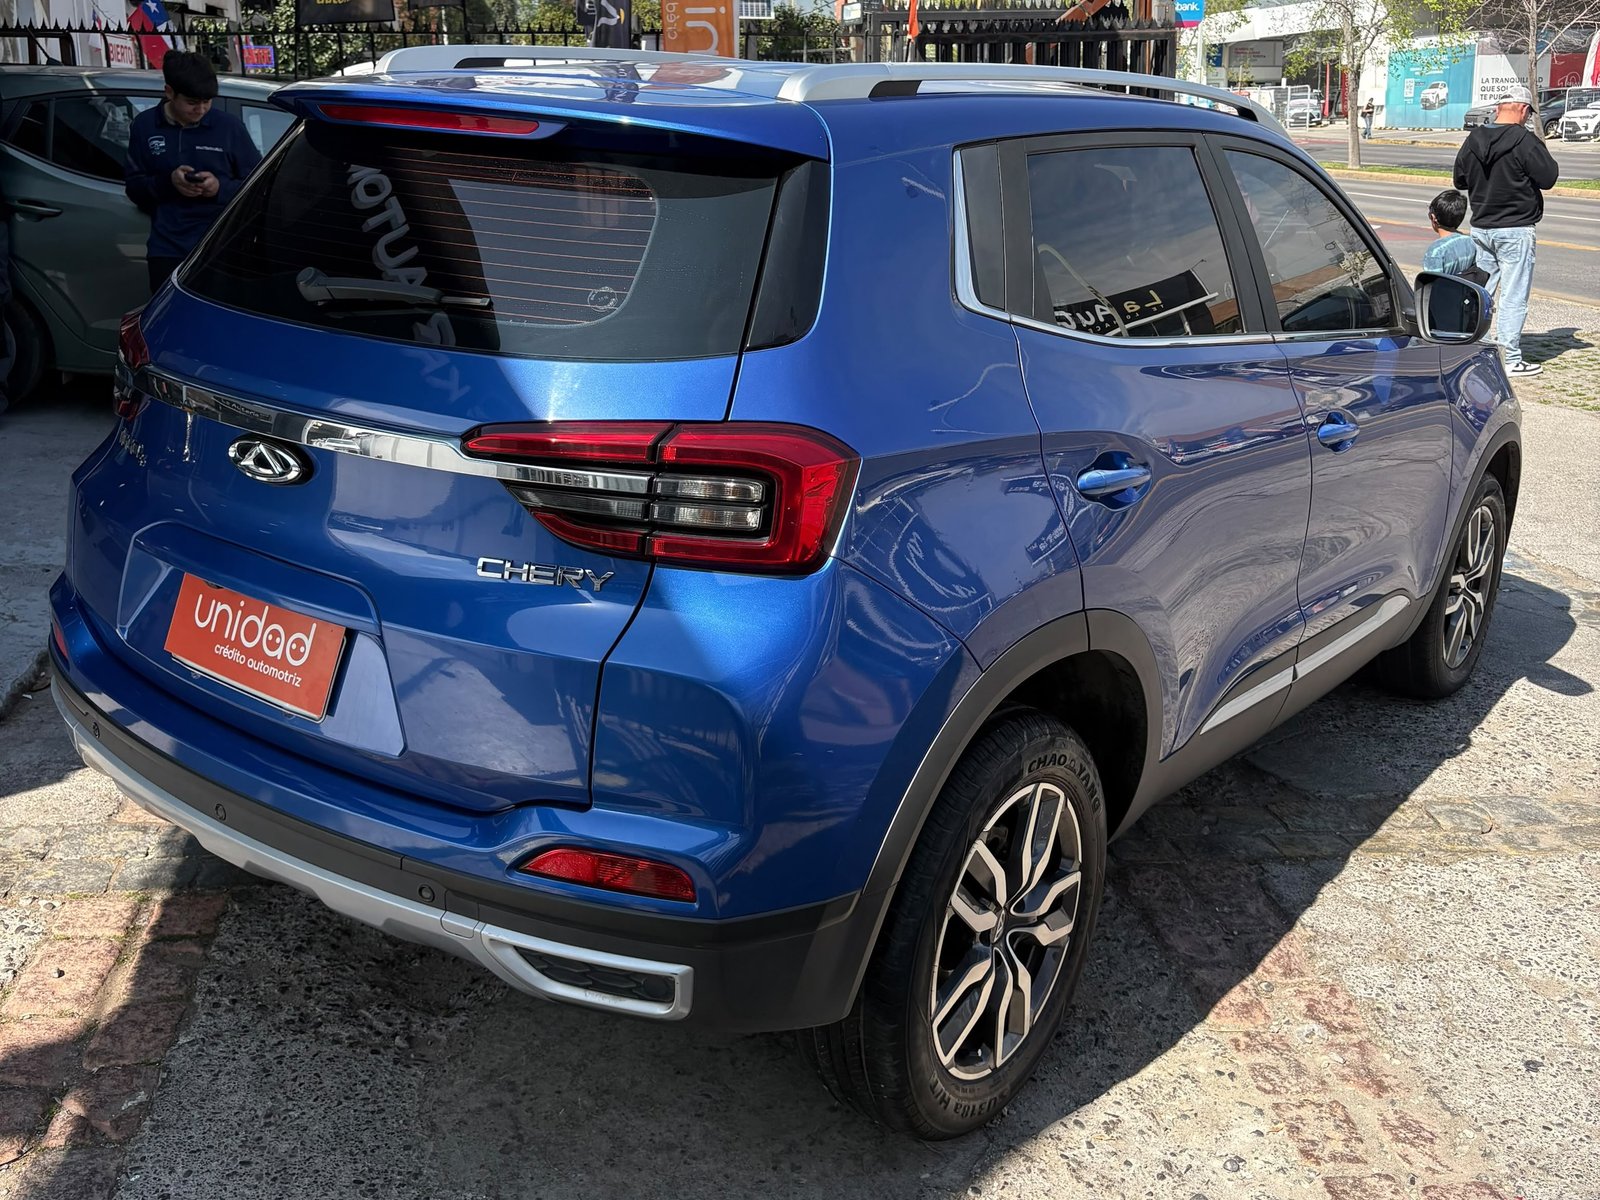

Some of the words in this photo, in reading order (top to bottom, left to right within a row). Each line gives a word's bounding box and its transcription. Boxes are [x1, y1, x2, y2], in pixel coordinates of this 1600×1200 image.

[108, 42, 134, 65] BIERTO
[1491, 76, 1544, 84] TRANQUILID
[1480, 93, 1488, 101] TE
[476, 556, 615, 593] CHERY
[194, 593, 317, 667] unidad
[214, 643, 246, 665] crédito
[247, 658, 302, 688] automotriz
